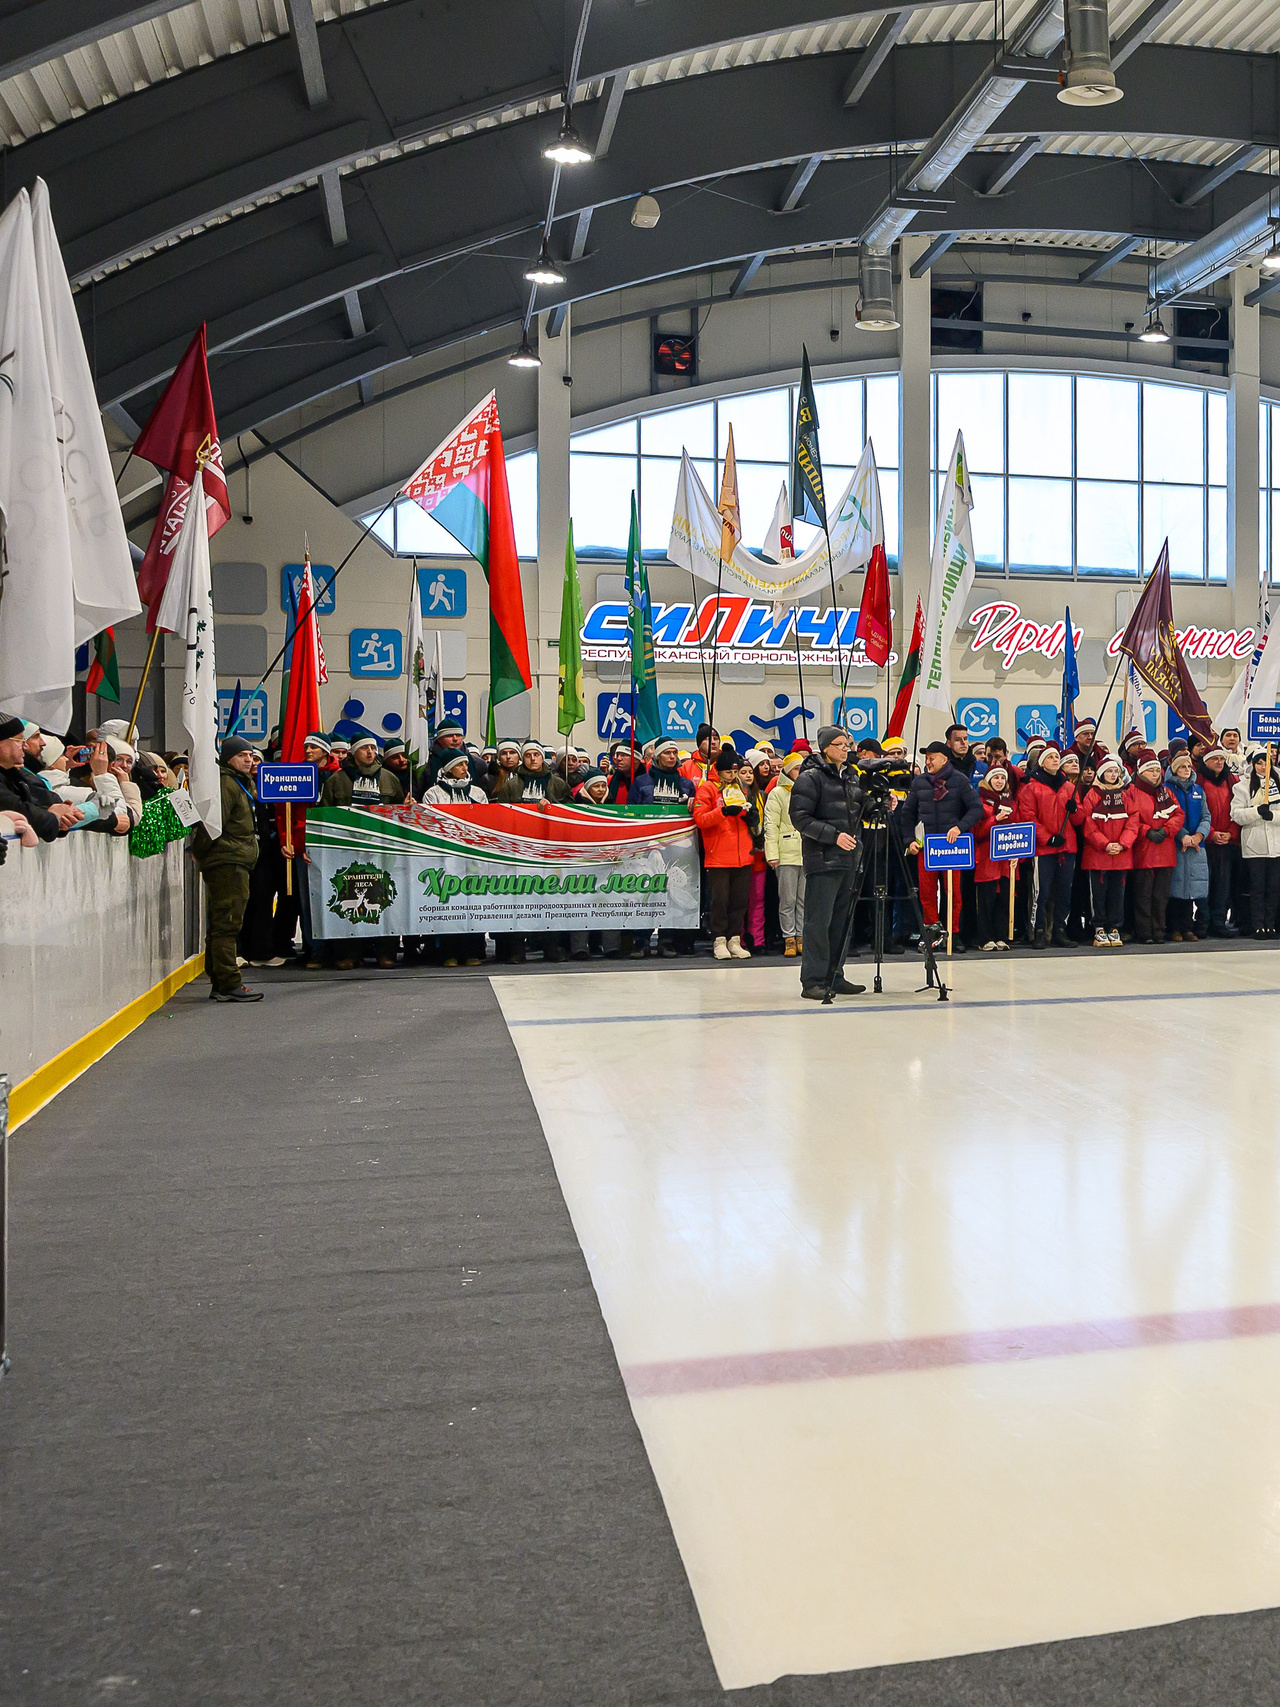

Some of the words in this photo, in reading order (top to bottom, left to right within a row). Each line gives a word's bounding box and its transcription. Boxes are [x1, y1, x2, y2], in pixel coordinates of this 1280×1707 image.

[1109, 626, 1253, 658] оичное
[581, 648, 730, 661] РЕСПУКАНСКИЙ
[980, 713, 997, 726] 24
[264, 773, 312, 785] Хранители
[929, 846, 969, 857] Агрохолдинг
[343, 873, 384, 881] ХРАНИТЕЛИ
[418, 868, 598, 904] Хранители
[600, 873, 668, 894] леса
[419, 904, 450, 912] сборная
[483, 903, 525, 912] работников
[525, 903, 591, 911] природоохранных
[419, 914, 467, 923] учреждений
[469, 912, 514, 921] Управления
[545, 911, 588, 919] Президента
[591, 910, 633, 919] Республики
[635, 909, 666, 918] Беларусь
